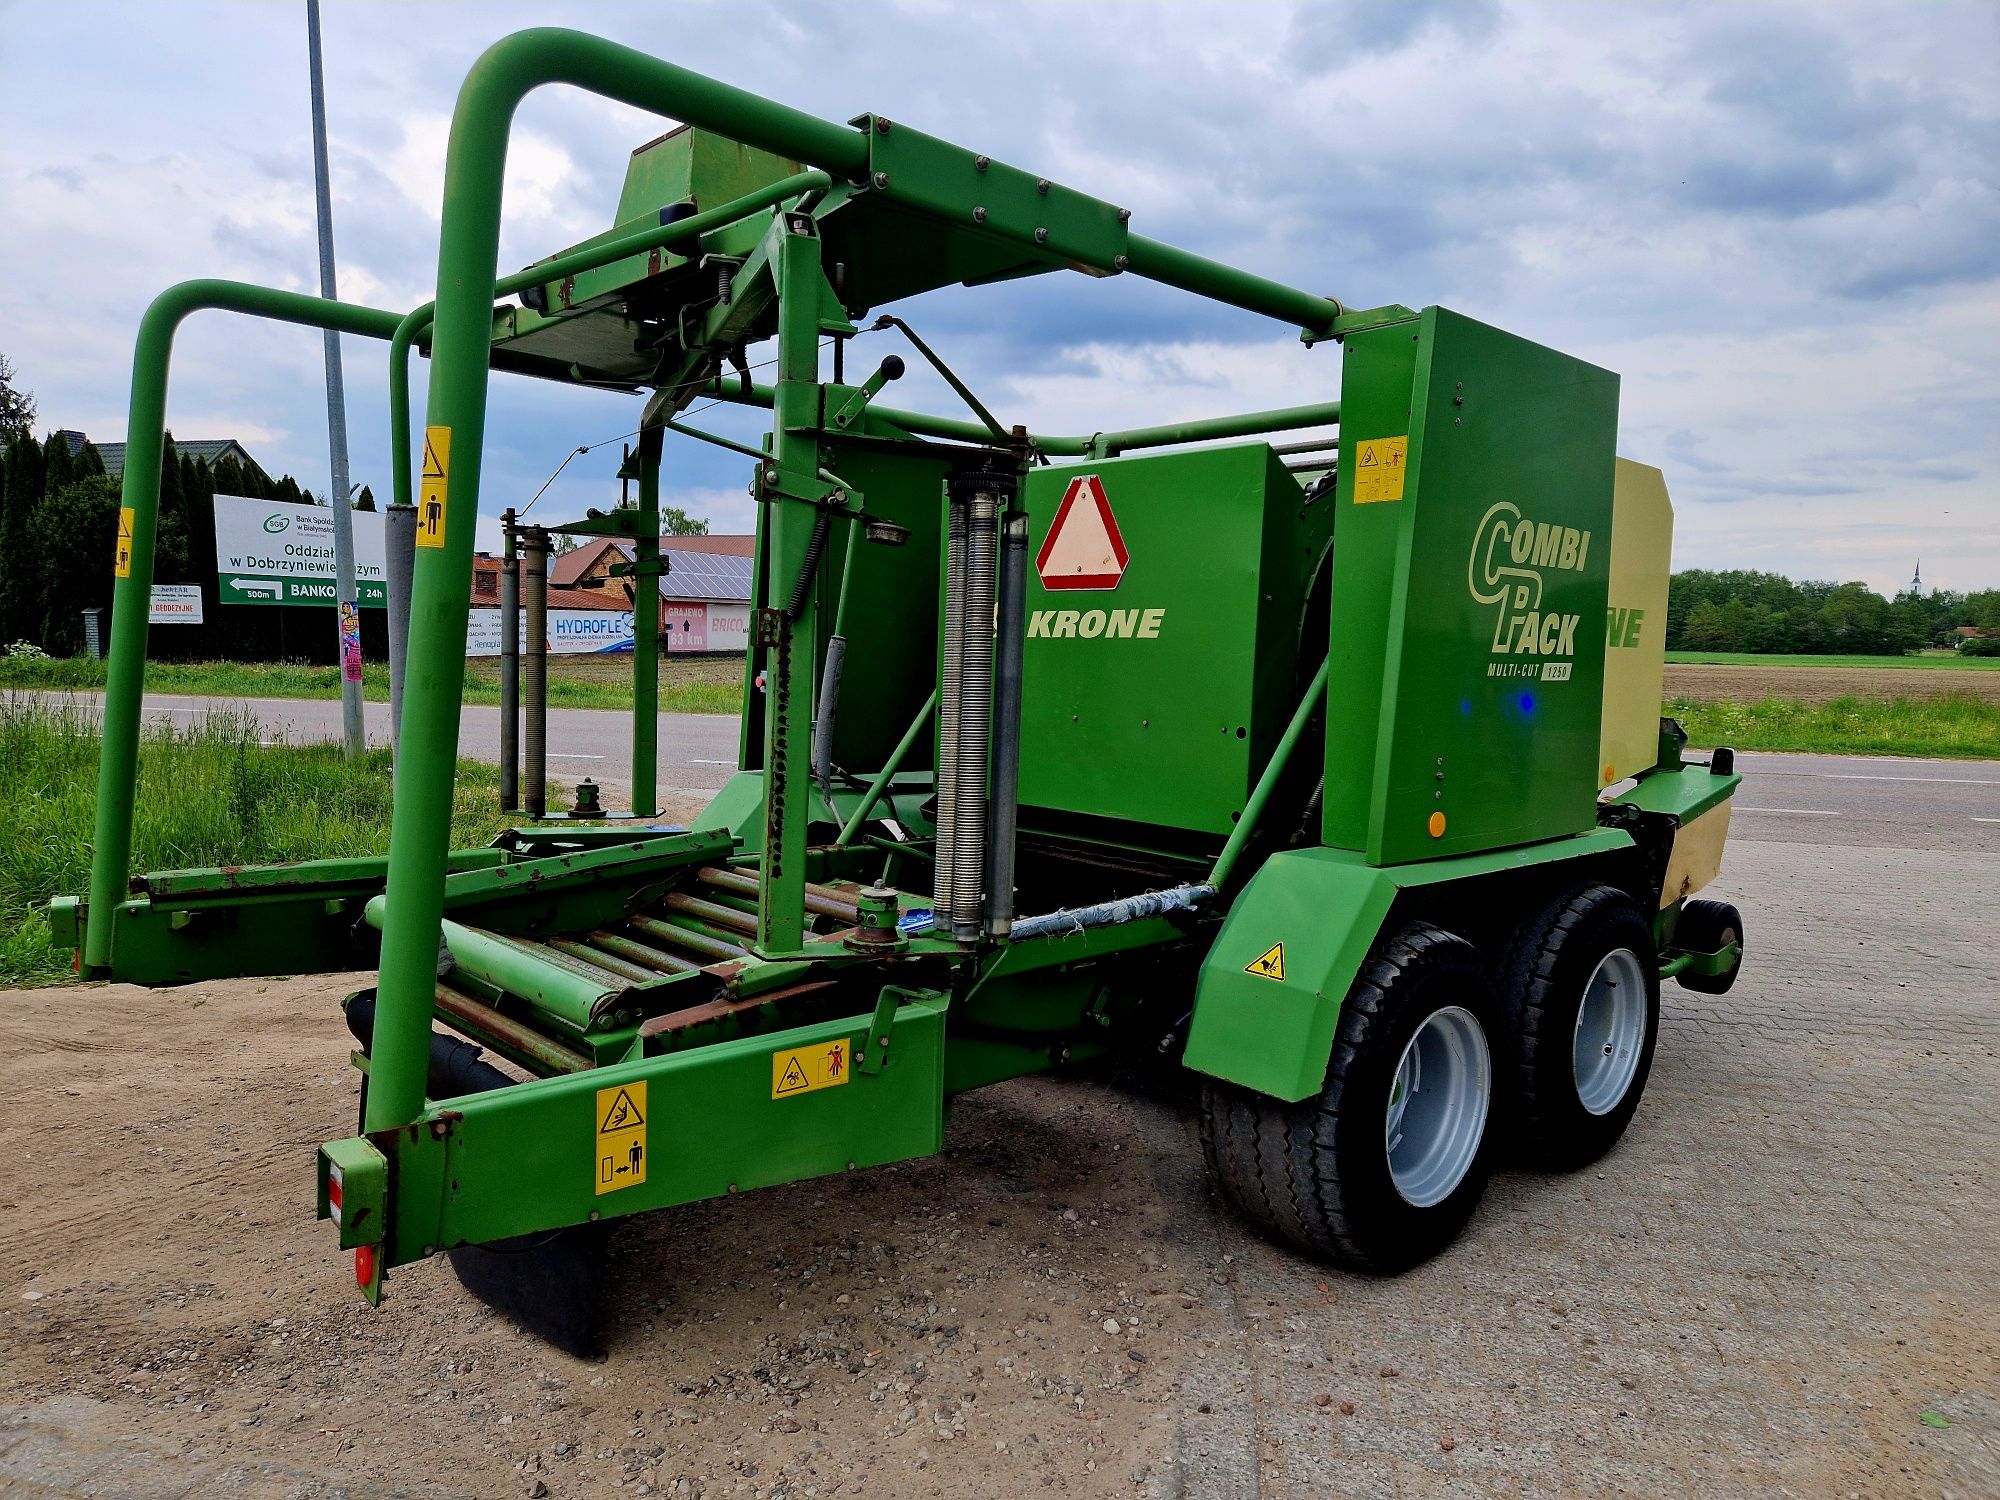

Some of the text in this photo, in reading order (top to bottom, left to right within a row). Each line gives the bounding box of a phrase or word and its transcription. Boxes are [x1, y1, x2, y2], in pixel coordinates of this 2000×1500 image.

[269, 520, 284, 528] SGB
[295, 515, 335, 526] Bank Spółdz
[284, 543, 335, 559] Oddział
[1468, 501, 1592, 604] COMBI
[230, 556, 242, 568] w
[247, 583, 383, 599] 500m BANKOT 24h
[668, 607, 703, 617] GRAJEWO
[1492, 567, 1580, 656] PACK
[711, 617, 744, 632] BRICO
[1026, 608, 1166, 639] KRONE
[670, 632, 703, 646] 63 km
[1487, 663, 1568, 678] MULTI-CUT 1250
